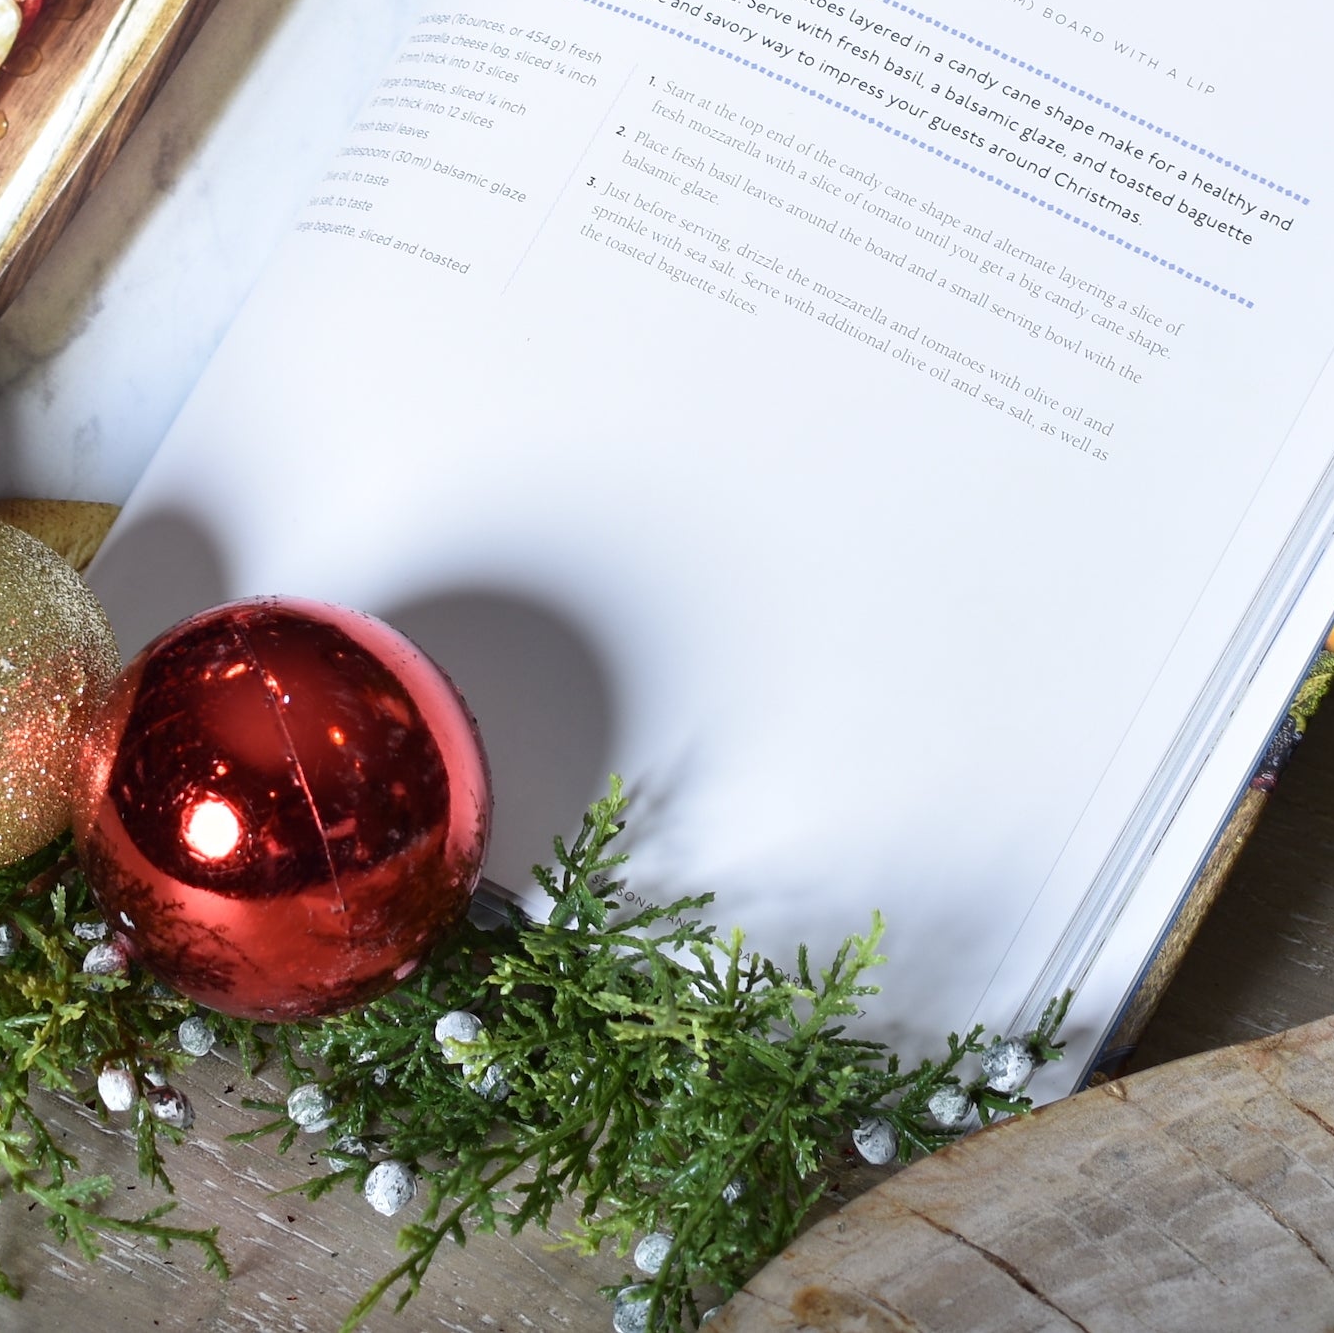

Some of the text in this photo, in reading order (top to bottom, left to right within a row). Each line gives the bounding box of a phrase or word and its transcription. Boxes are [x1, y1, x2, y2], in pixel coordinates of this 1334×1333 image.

[513, 50, 597, 88] sliced inch
[567, 42, 602, 65] fresh
[1042, 4, 1105, 43] BOARD
[1114, 39, 1160, 70] WITH
[1165, 65, 1178, 80] A
[1186, 75, 1216, 96] LIP
[449, 84, 527, 117] sliced inch
[459, 110, 495, 129] slices
[703, 11, 759, 43] savory
[761, 35, 795, 59] way
[797, 50, 815, 67] to
[818, 59, 885, 100] impress
[884, 94, 930, 119] your
[927, 115, 986, 148] guests
[988, 143, 1052, 179] around
[1054, 172, 1143, 227] Christmas.
[796, 19, 833, 44] with
[836, 35, 880, 66] fresh
[883, 56, 925, 90] basil,
[930, 83, 941, 95] a
[944, 85, 1020, 132] balsamic
[1018, 126, 1067, 158] glaze,
[1072, 151, 1108, 174] and
[1109, 166, 1176, 207] toasted
[1176, 198, 1253, 246] baguette
[848, 7, 914, 48] layered
[914, 40, 931, 58] in
[933, 52, 945, 64] a
[947, 59, 1000, 91] candy
[1001, 85, 1041, 110] cane
[1043, 105, 1095, 136] shape
[1097, 131, 1144, 160] make
[1147, 152, 1176, 174] for
[1177, 169, 1188, 182] a
[1190, 172, 1258, 216] healthy
[1259, 209, 1295, 232] and
[432, 159, 527, 203] balsamic glaze
[621, 149, 720, 206] balsamic glaze.
[648, 75, 1186, 337] 1. Start at the top end of the candy cane shape and alternate layering a slice of
[357, 228, 472, 275] sliced and toasted
[614, 123, 1143, 385] 2. Place fresh basil leaves around the board and a small serving bowl with the
[651, 99, 1171, 360] fresh mozzarella with a slice of tomato until you get a big candy cane shape.
[585, 175, 1115, 437] 3. Just before serving, drizzle the mozzarella and tomatoes with olive oil and
